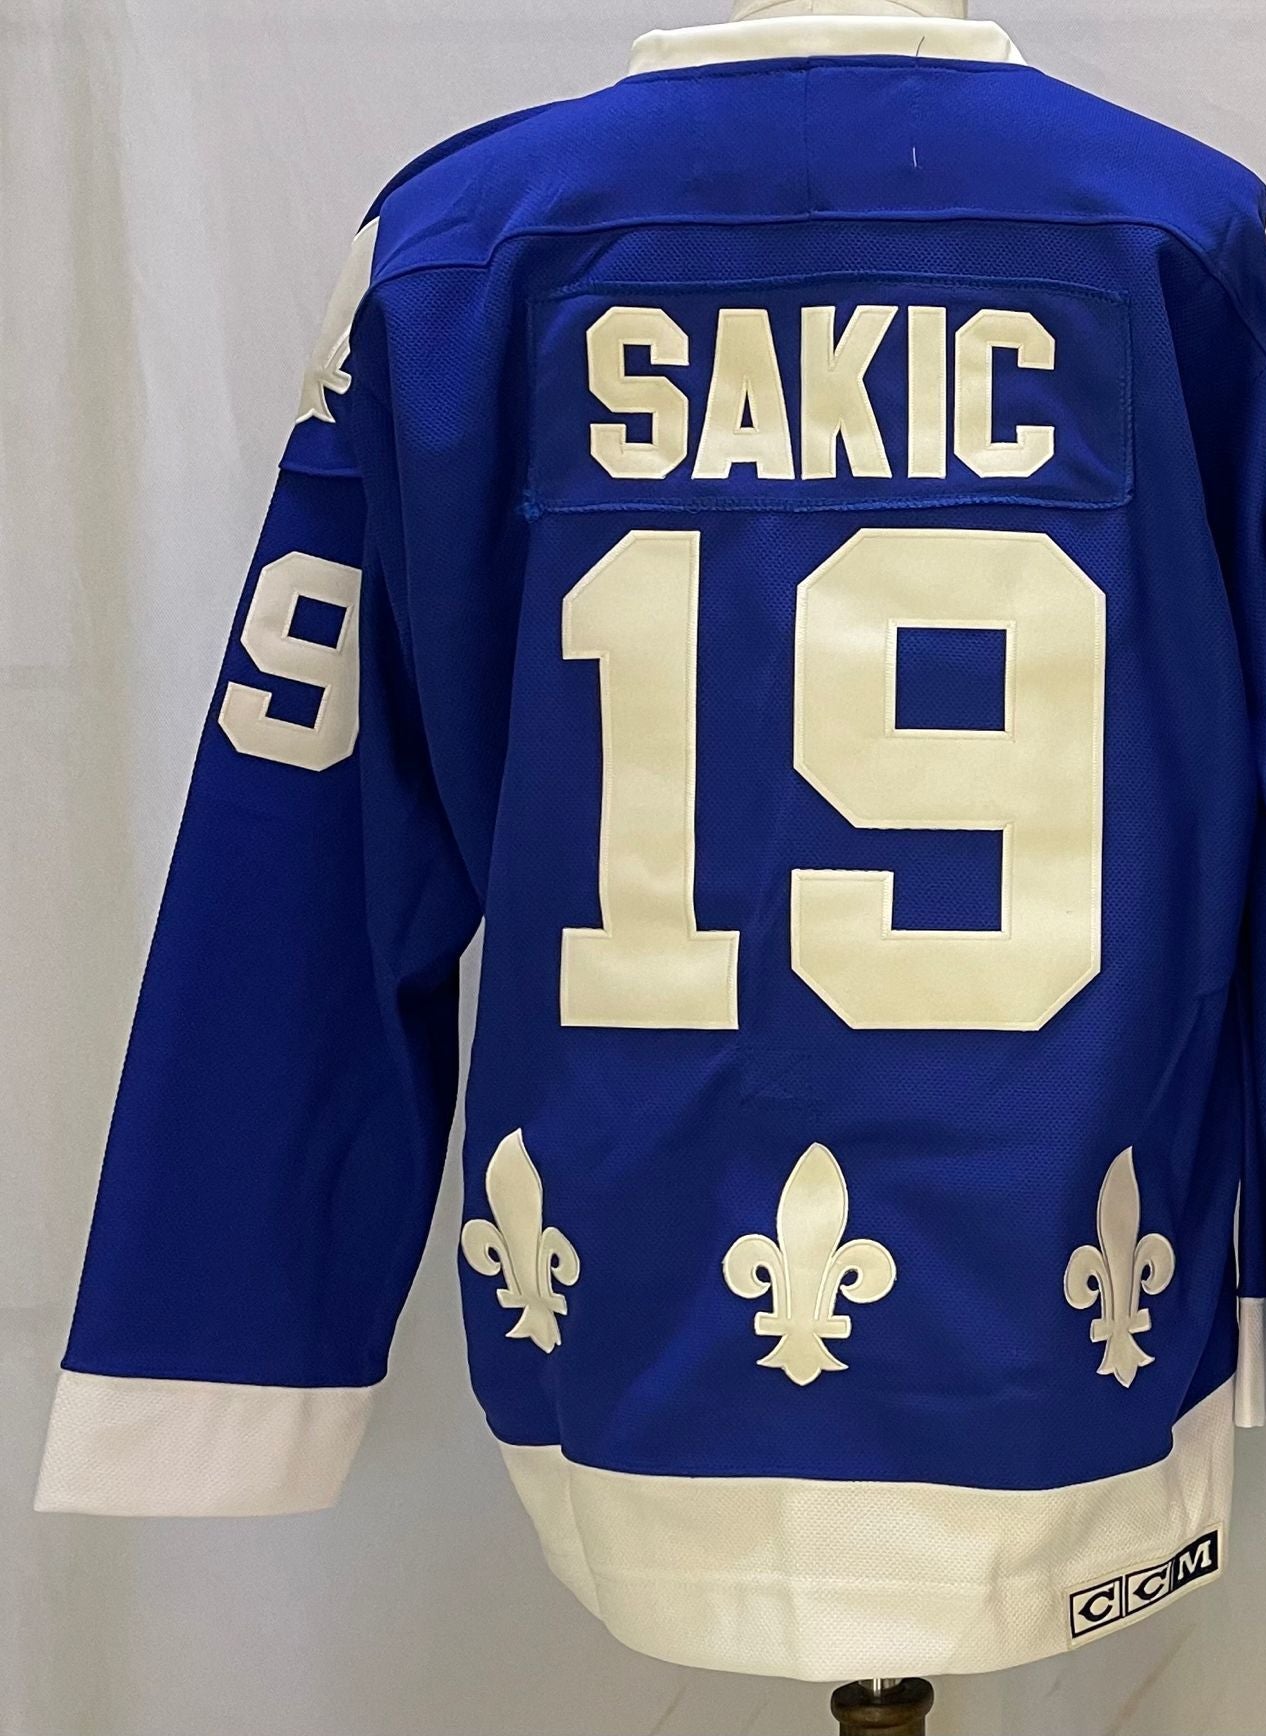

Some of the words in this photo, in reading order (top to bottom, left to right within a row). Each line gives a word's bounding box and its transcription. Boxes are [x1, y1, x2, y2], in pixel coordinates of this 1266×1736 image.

[586, 305, 1056, 480] SAKIC
[217, 550, 363, 772] 9
[560, 528, 1106, 1031] 19
[1077, 1539, 1213, 1623] CCM
